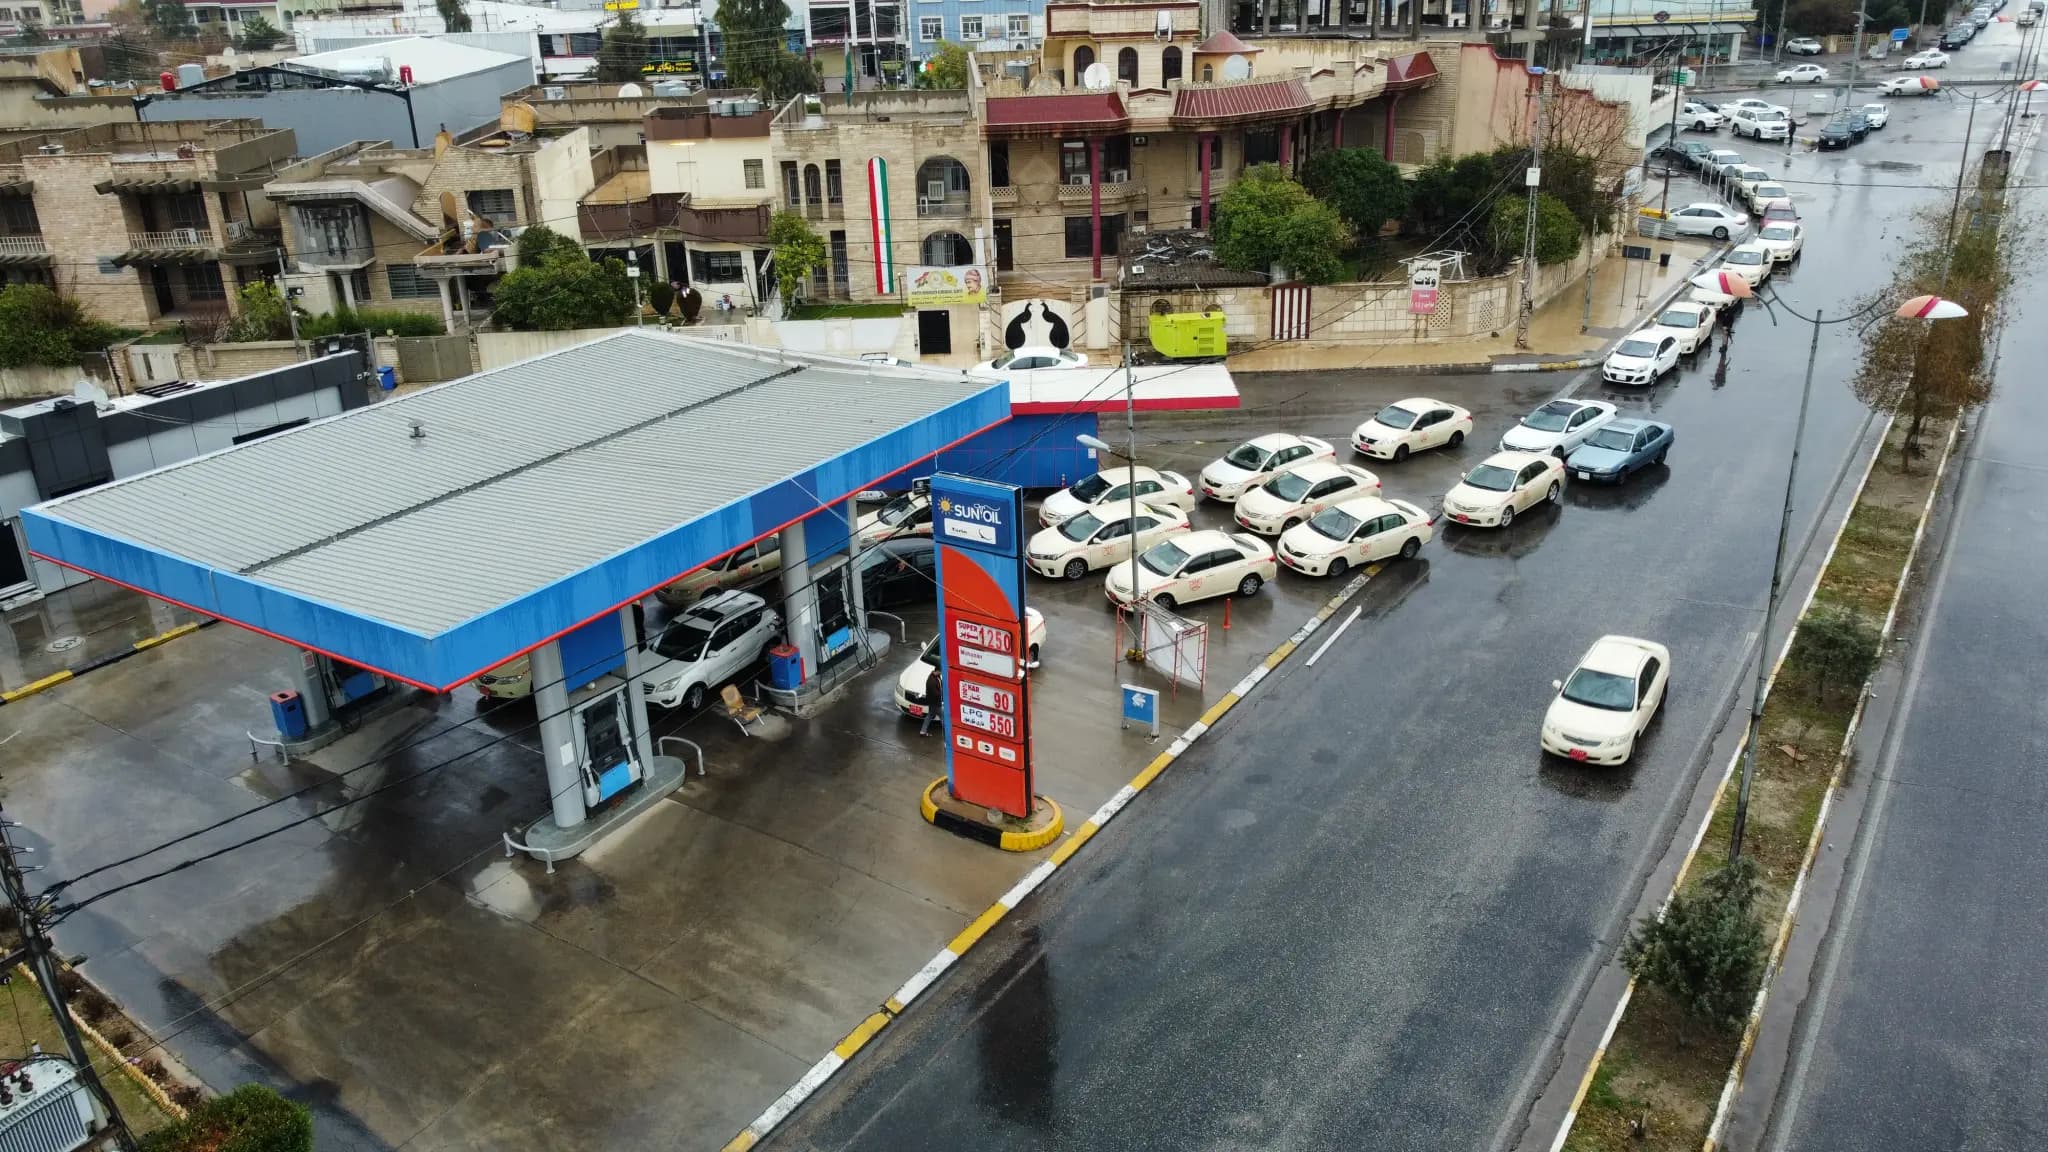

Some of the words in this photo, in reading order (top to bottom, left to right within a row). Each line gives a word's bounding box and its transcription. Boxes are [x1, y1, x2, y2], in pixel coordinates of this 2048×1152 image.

[958, 622, 978, 632] SUPER
[980, 626, 1011, 651] 1250
[994, 692, 1009, 711] 90
[962, 706, 983, 718] LPG
[989, 713, 1012, 736] 550
